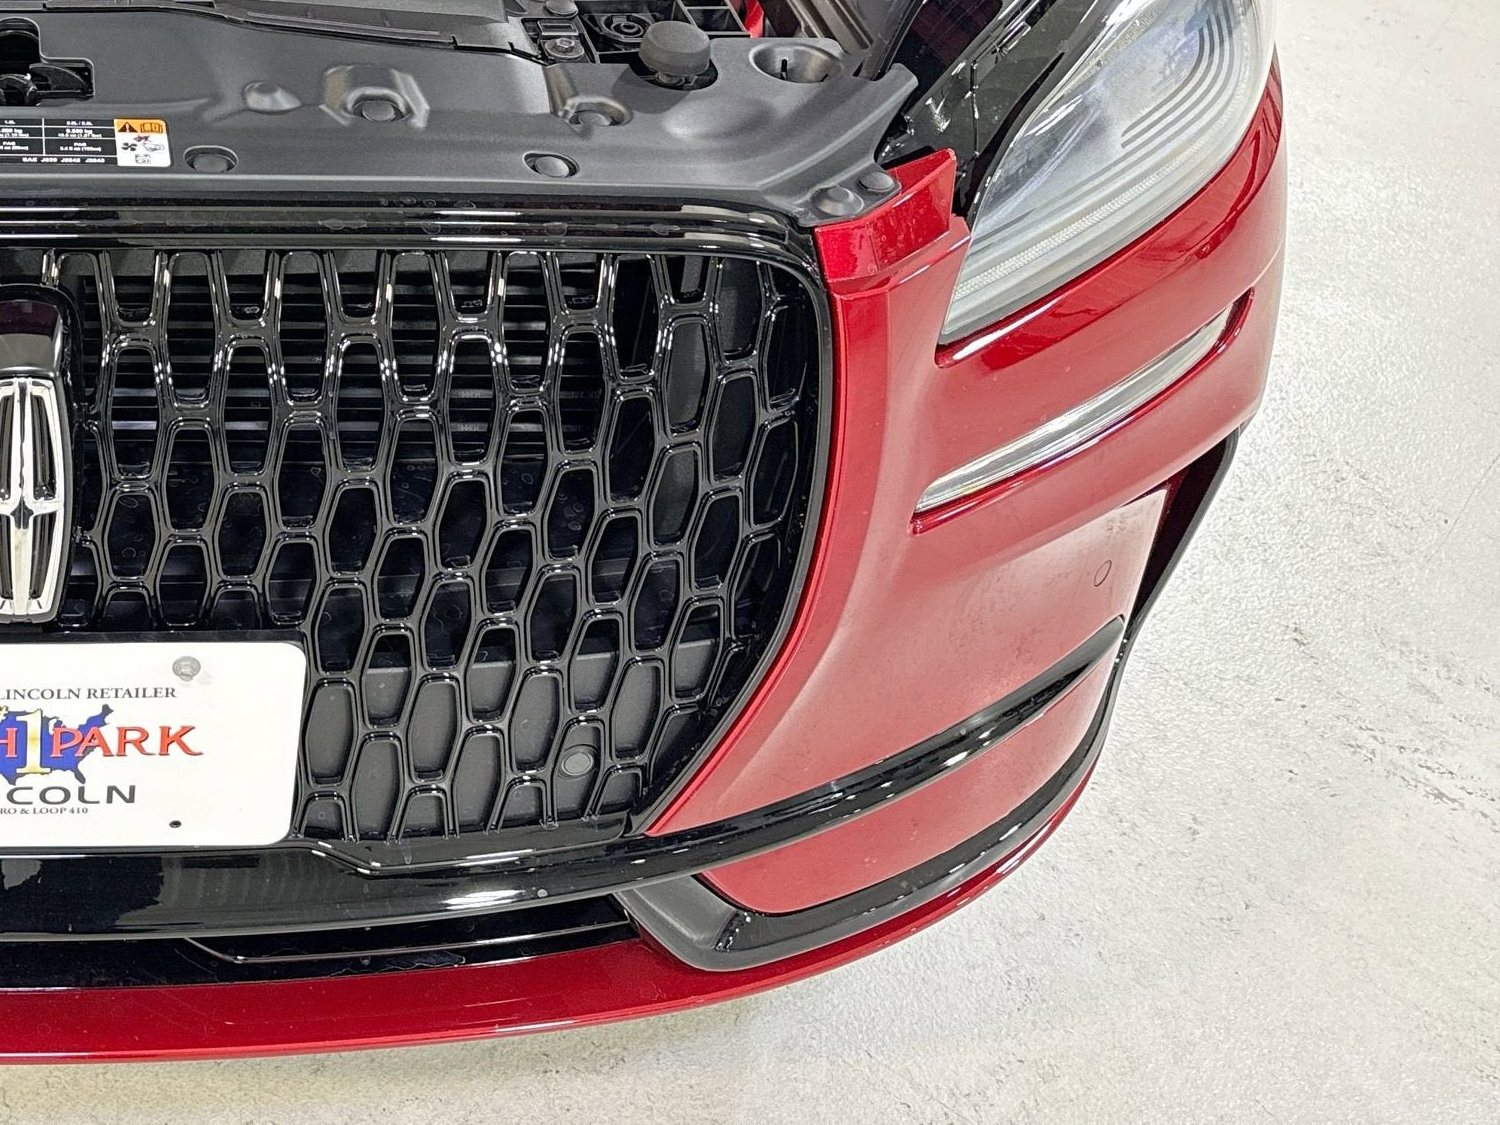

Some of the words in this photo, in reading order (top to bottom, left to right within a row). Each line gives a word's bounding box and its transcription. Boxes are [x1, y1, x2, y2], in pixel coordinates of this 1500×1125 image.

[86, 687, 178, 700] RETAILER
[50, 725, 205, 758] PARK
[19, 807, 30, 815] &
[32, 806, 68, 815] LOOP
[69, 806, 89, 814] 410
